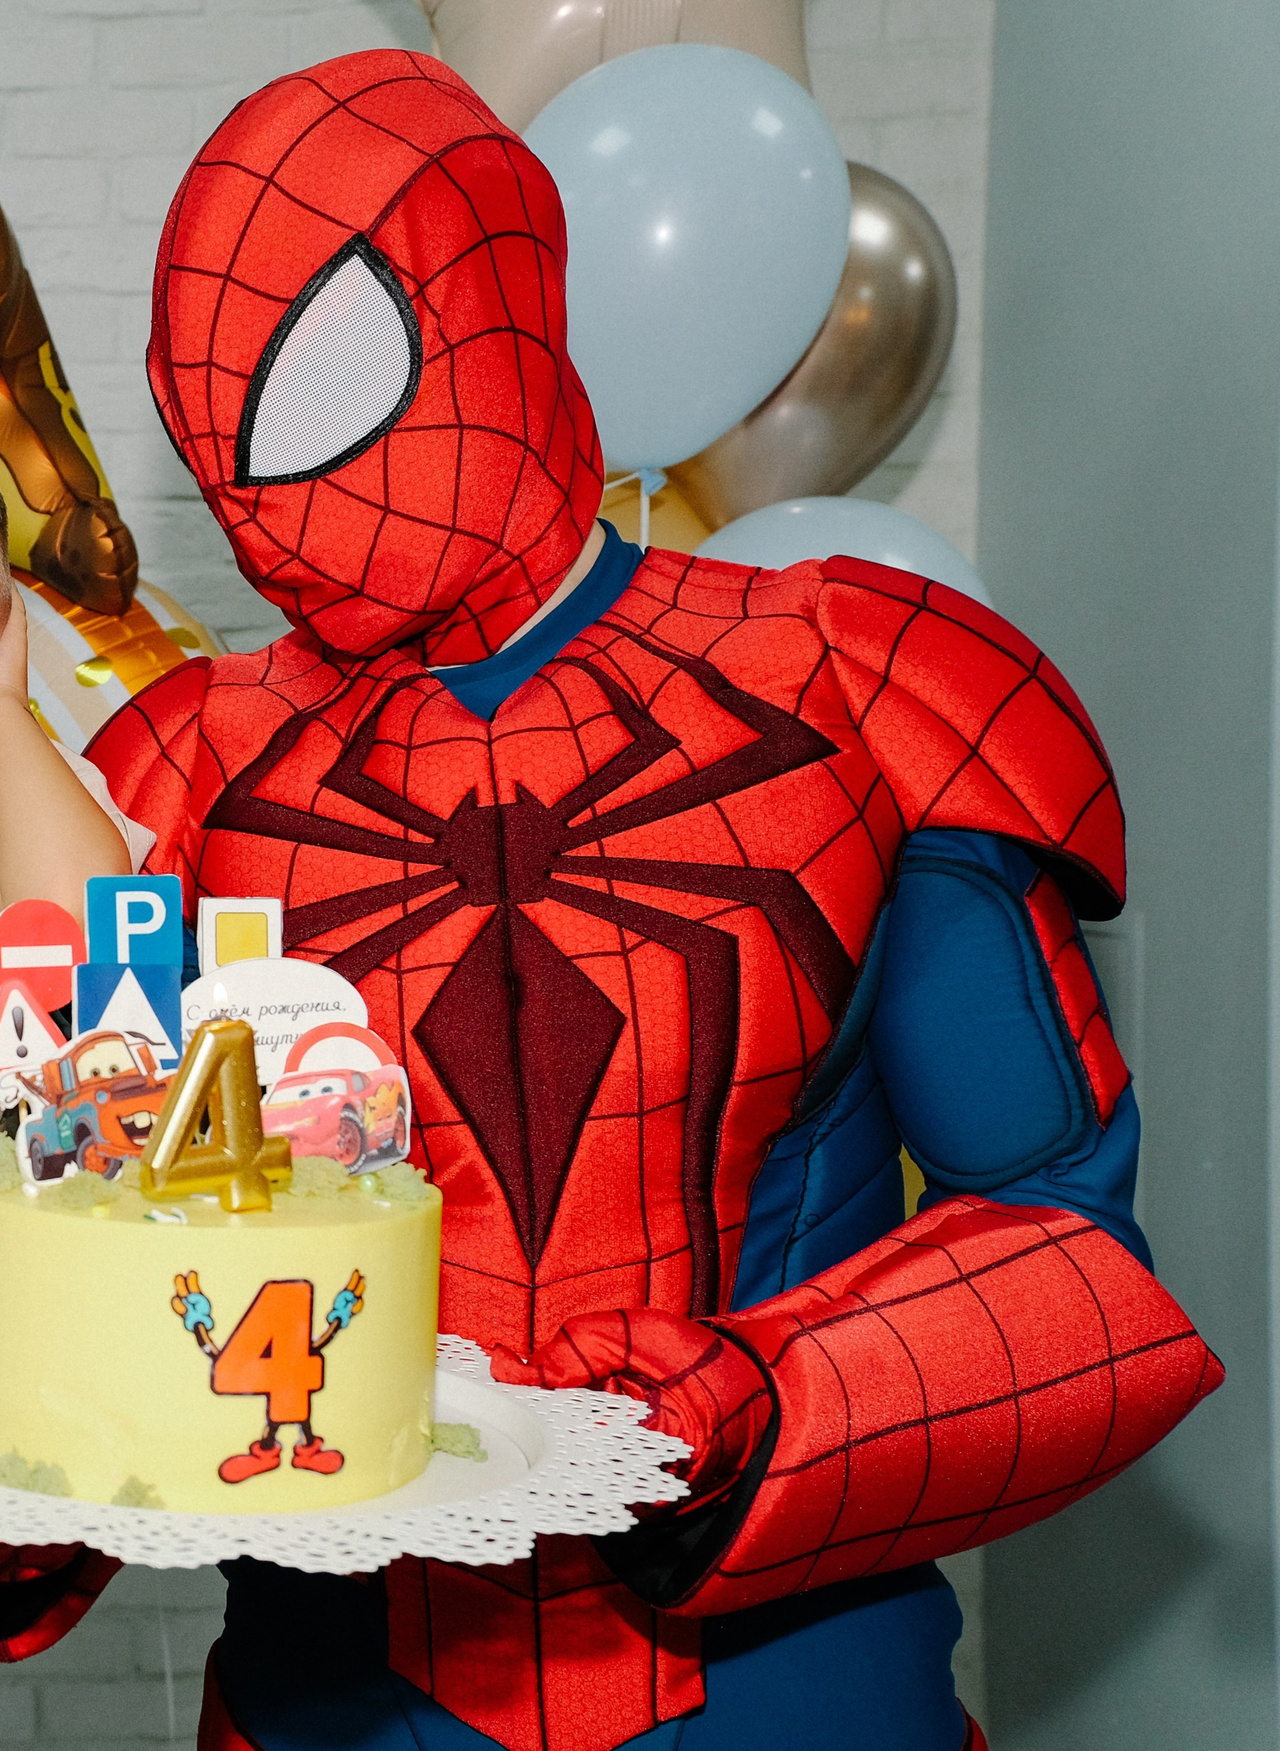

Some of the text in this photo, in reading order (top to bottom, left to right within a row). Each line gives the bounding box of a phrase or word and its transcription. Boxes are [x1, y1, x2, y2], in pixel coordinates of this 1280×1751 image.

[115, 891, 167, 963] P
[186, 1004, 201, 1021] С
[140, 1019, 293, 1213] 4
[210, 1279, 325, 1424] 4
